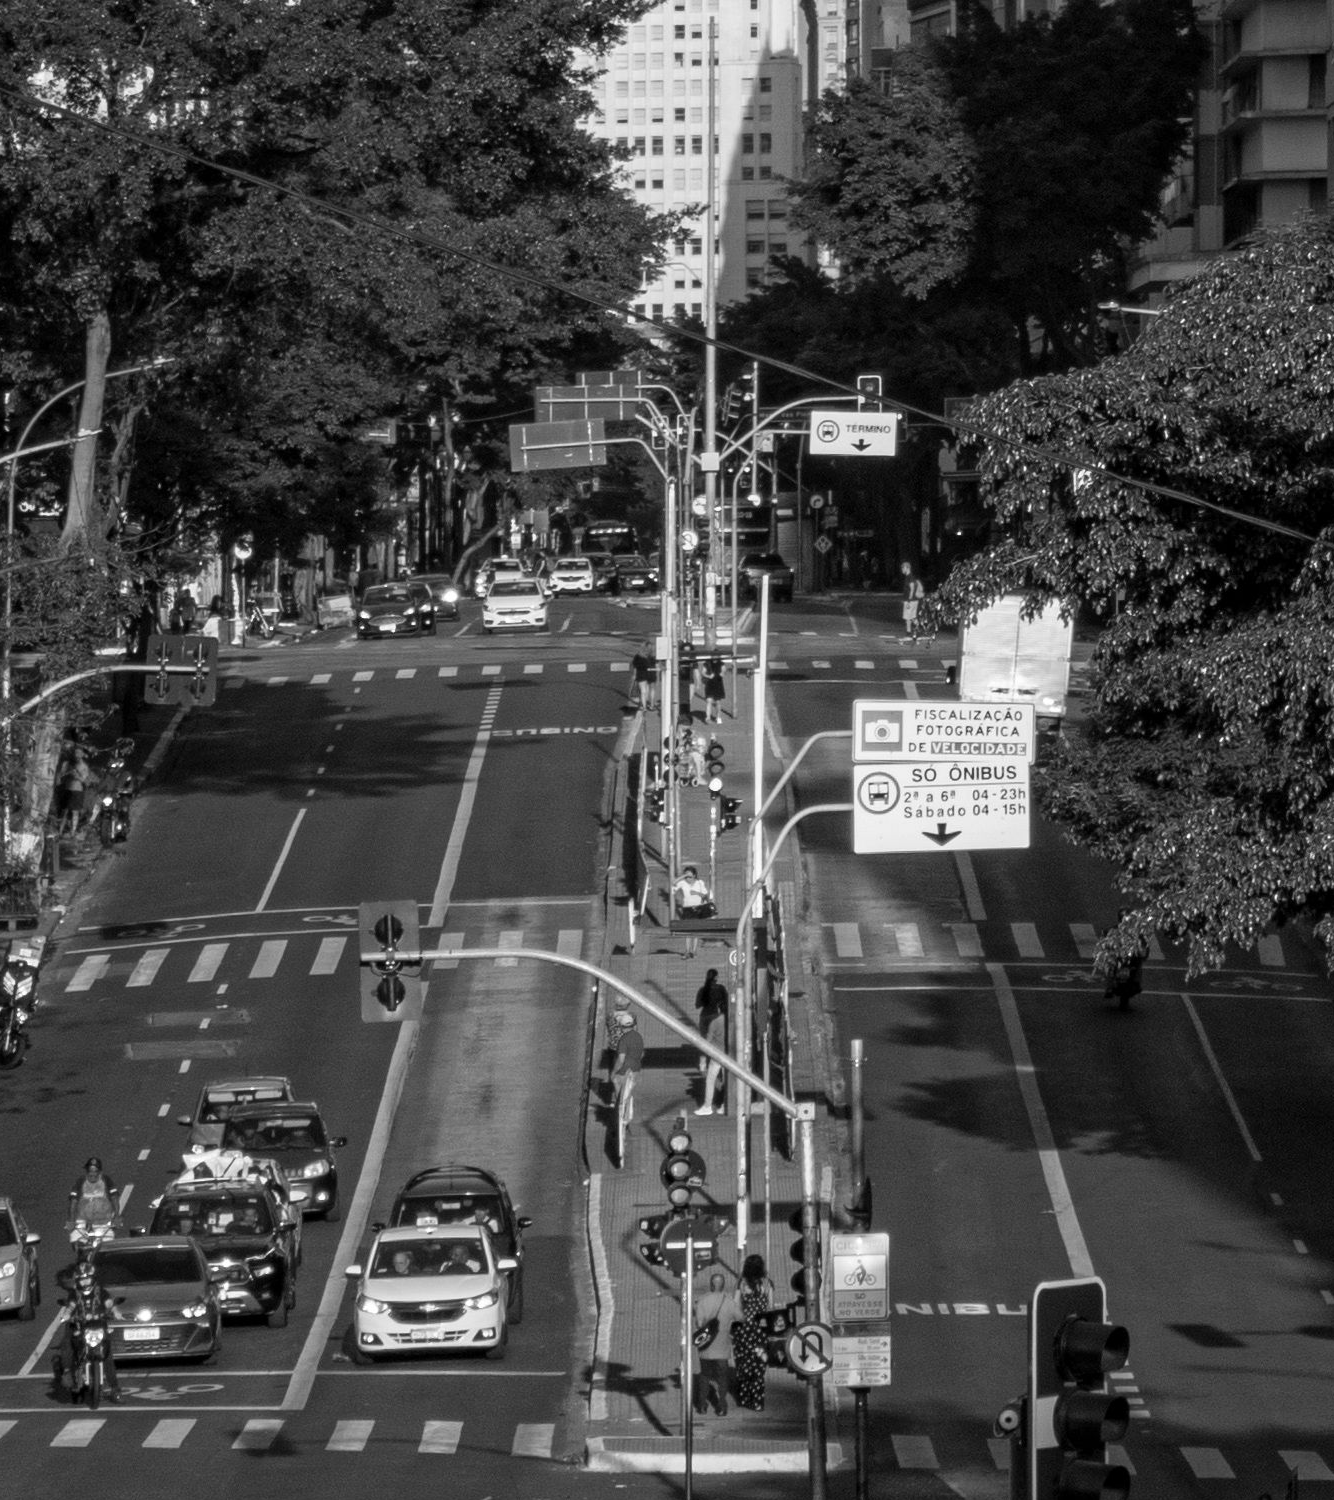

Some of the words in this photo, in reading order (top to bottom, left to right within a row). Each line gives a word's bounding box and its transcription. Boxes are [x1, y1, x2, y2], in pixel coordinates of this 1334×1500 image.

[914, 707, 1023, 722] FISCALIZAÇÃO
[916, 723, 1021, 738] FOTOGRÁFICA
[908, 742, 927, 753] DE
[931, 741, 1027, 755] VELOCIDADE
[911, 763, 937, 783] SÓ
[948, 763, 1018, 782] ÔNIBUS
[925, 792, 934, 803] a
[903, 805, 966, 819] Sábado
